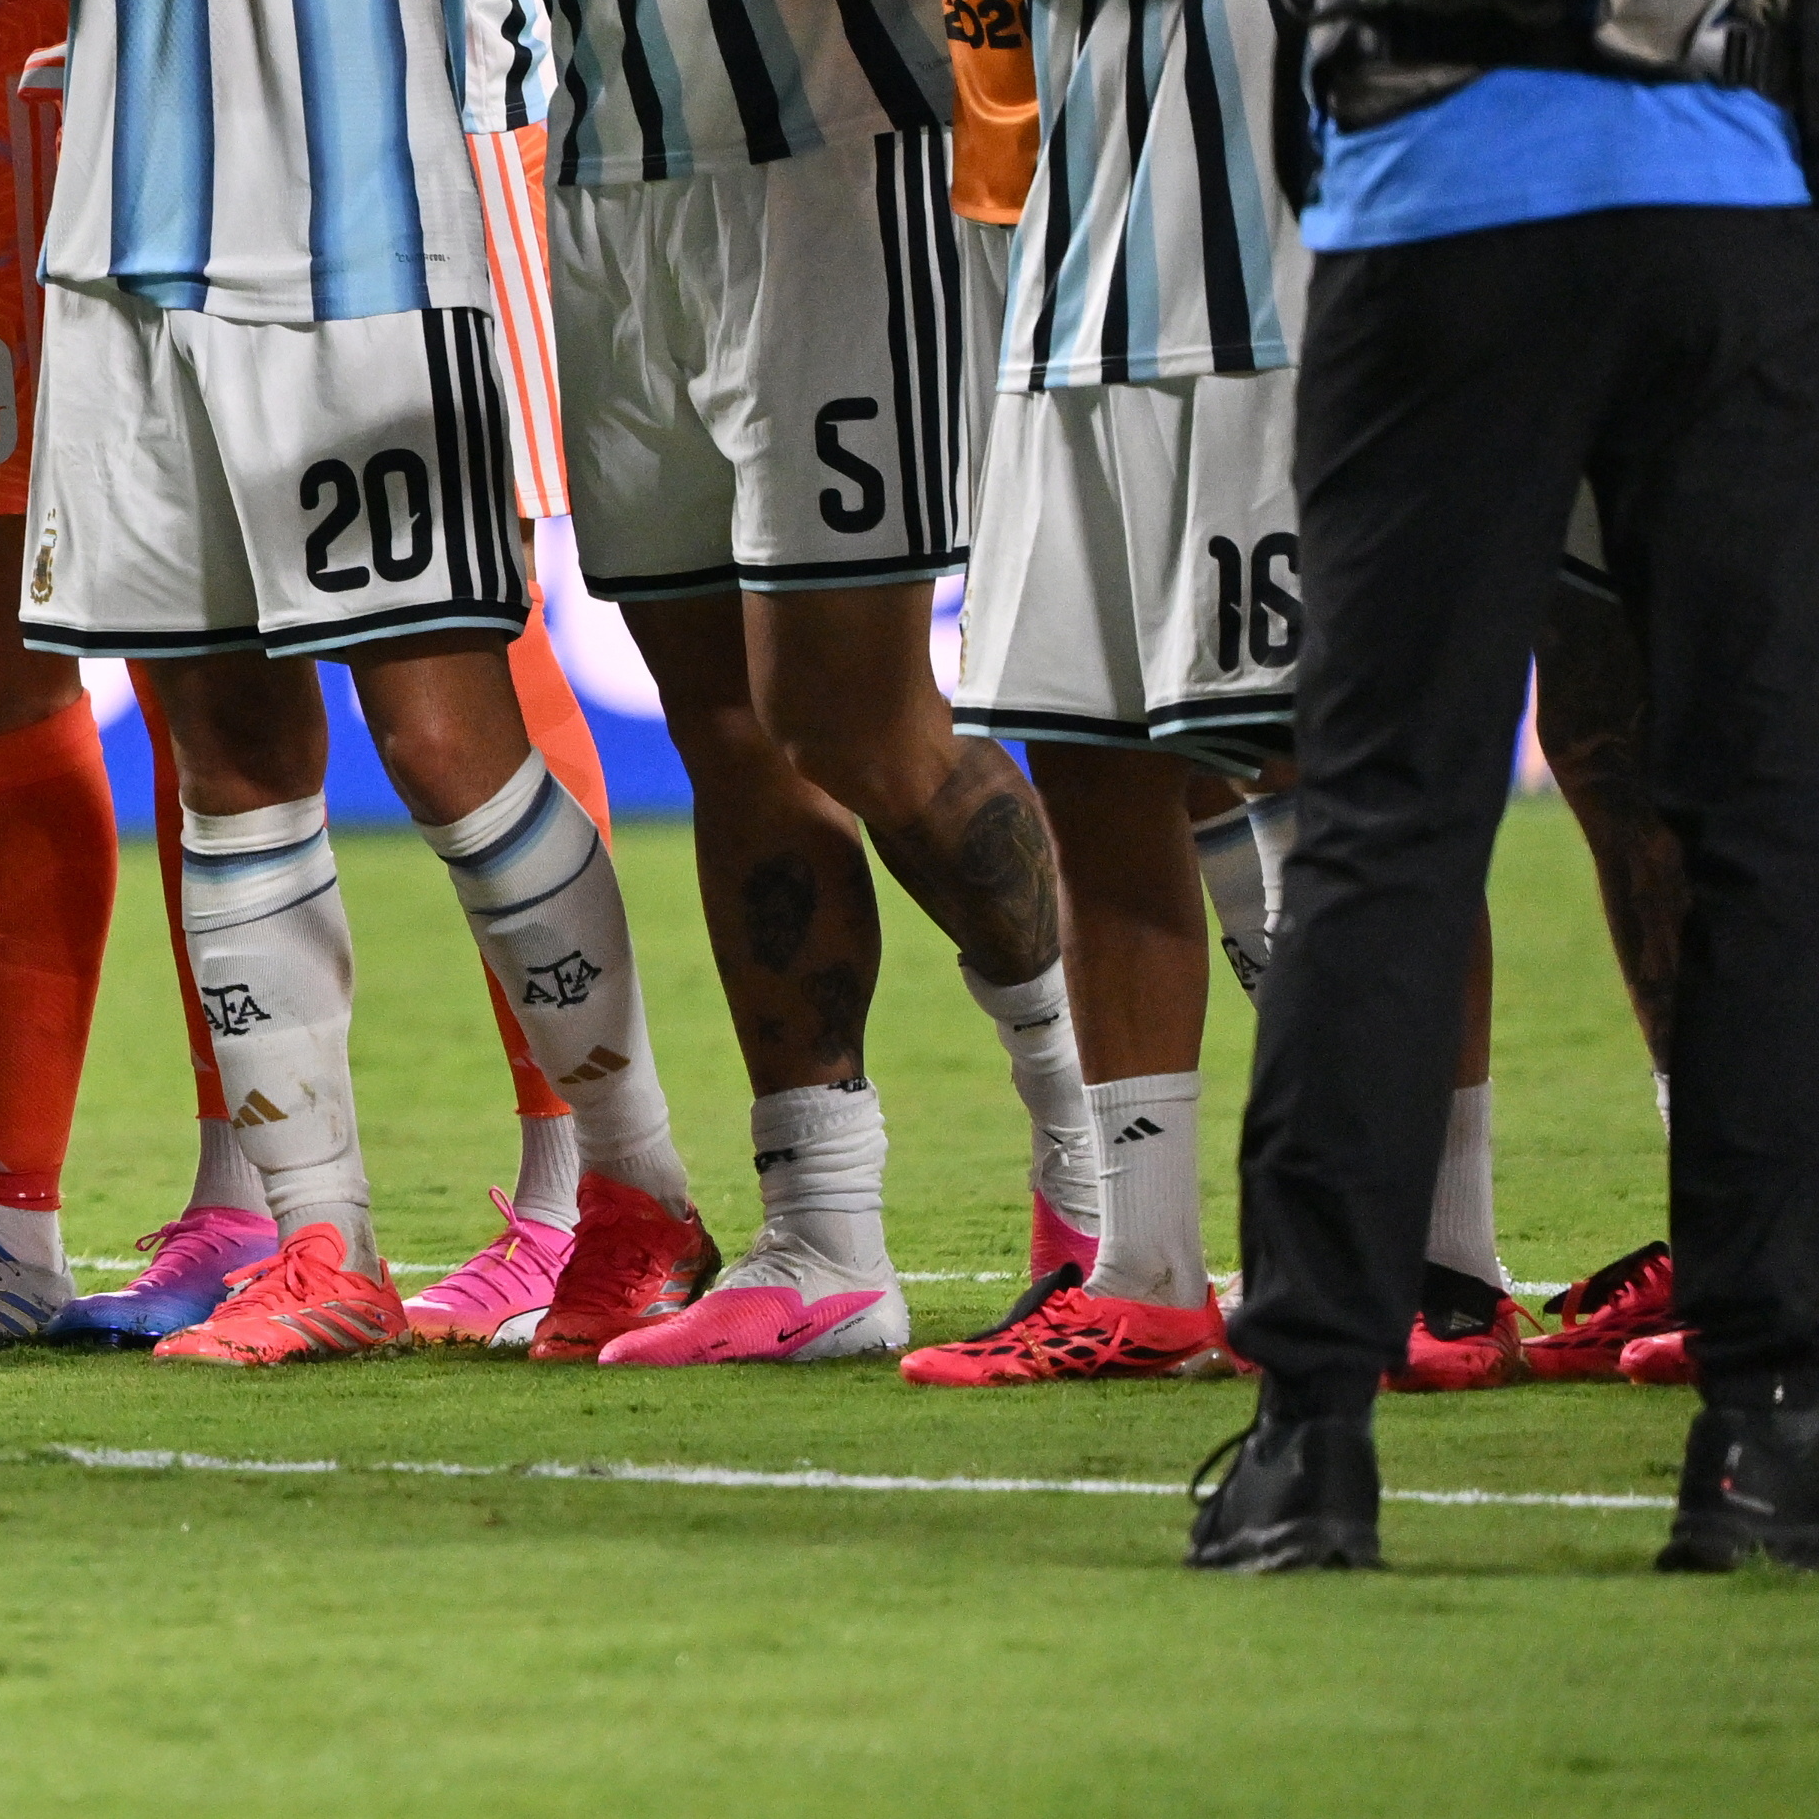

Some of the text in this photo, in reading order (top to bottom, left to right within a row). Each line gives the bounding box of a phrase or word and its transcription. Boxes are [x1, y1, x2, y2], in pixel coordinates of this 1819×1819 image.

[299, 447, 433, 593] 20
[816, 398, 885, 535] 5
[1209, 532, 1301, 671] 16
[203, 983, 272, 1037] AFA
[523, 950, 602, 1009] AFA
